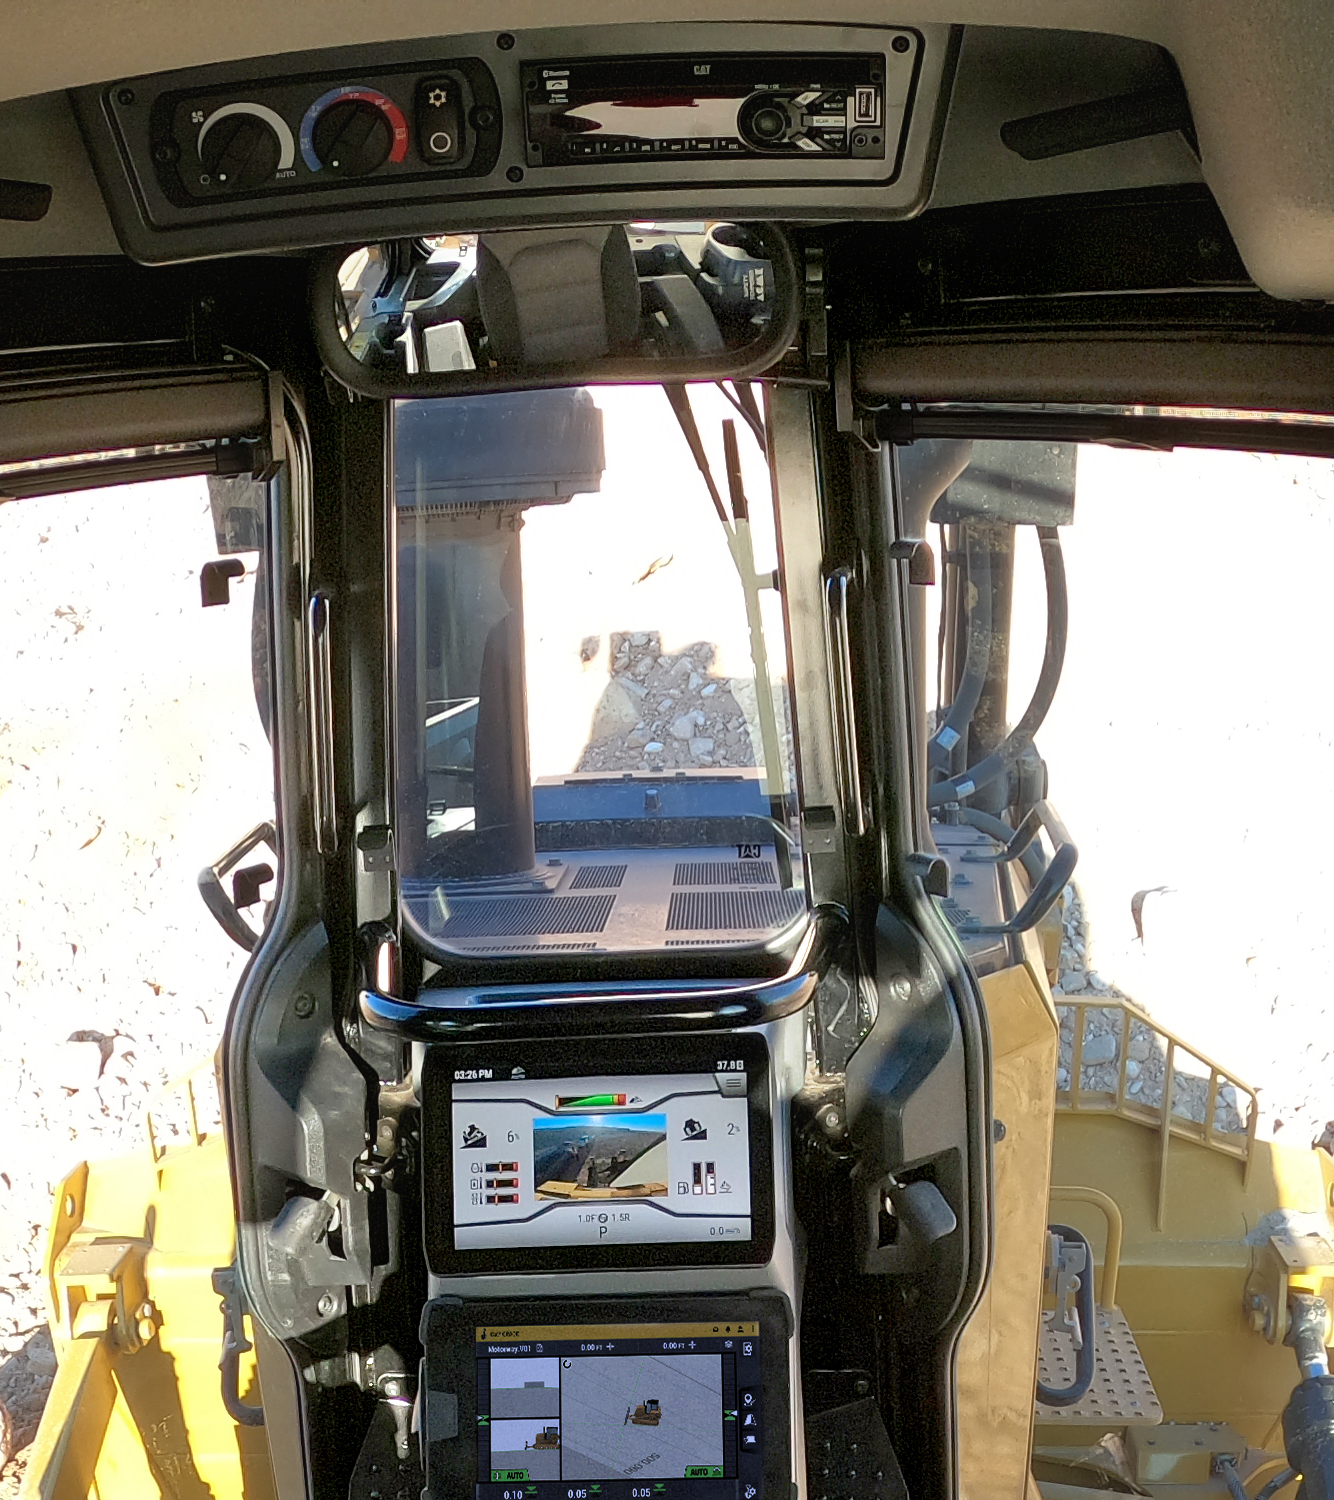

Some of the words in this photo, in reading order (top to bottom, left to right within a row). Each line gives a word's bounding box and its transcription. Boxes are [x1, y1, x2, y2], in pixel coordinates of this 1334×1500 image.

[694, 65, 711, 75] CAT
[275, 171, 297, 179] AUTO
[454, 1070, 478, 1080] 03:26
[479, 1069, 493, 1079] PM
[599, 1226, 608, 1239] P
[506, 1472, 524, 1480] AUTO
[690, 1468, 708, 1476] AUTO
[503, 1490, 523, 1500] 0.10
[567, 1489, 587, 1499] 0.05
[632, 1488, 651, 1498] 0.05
